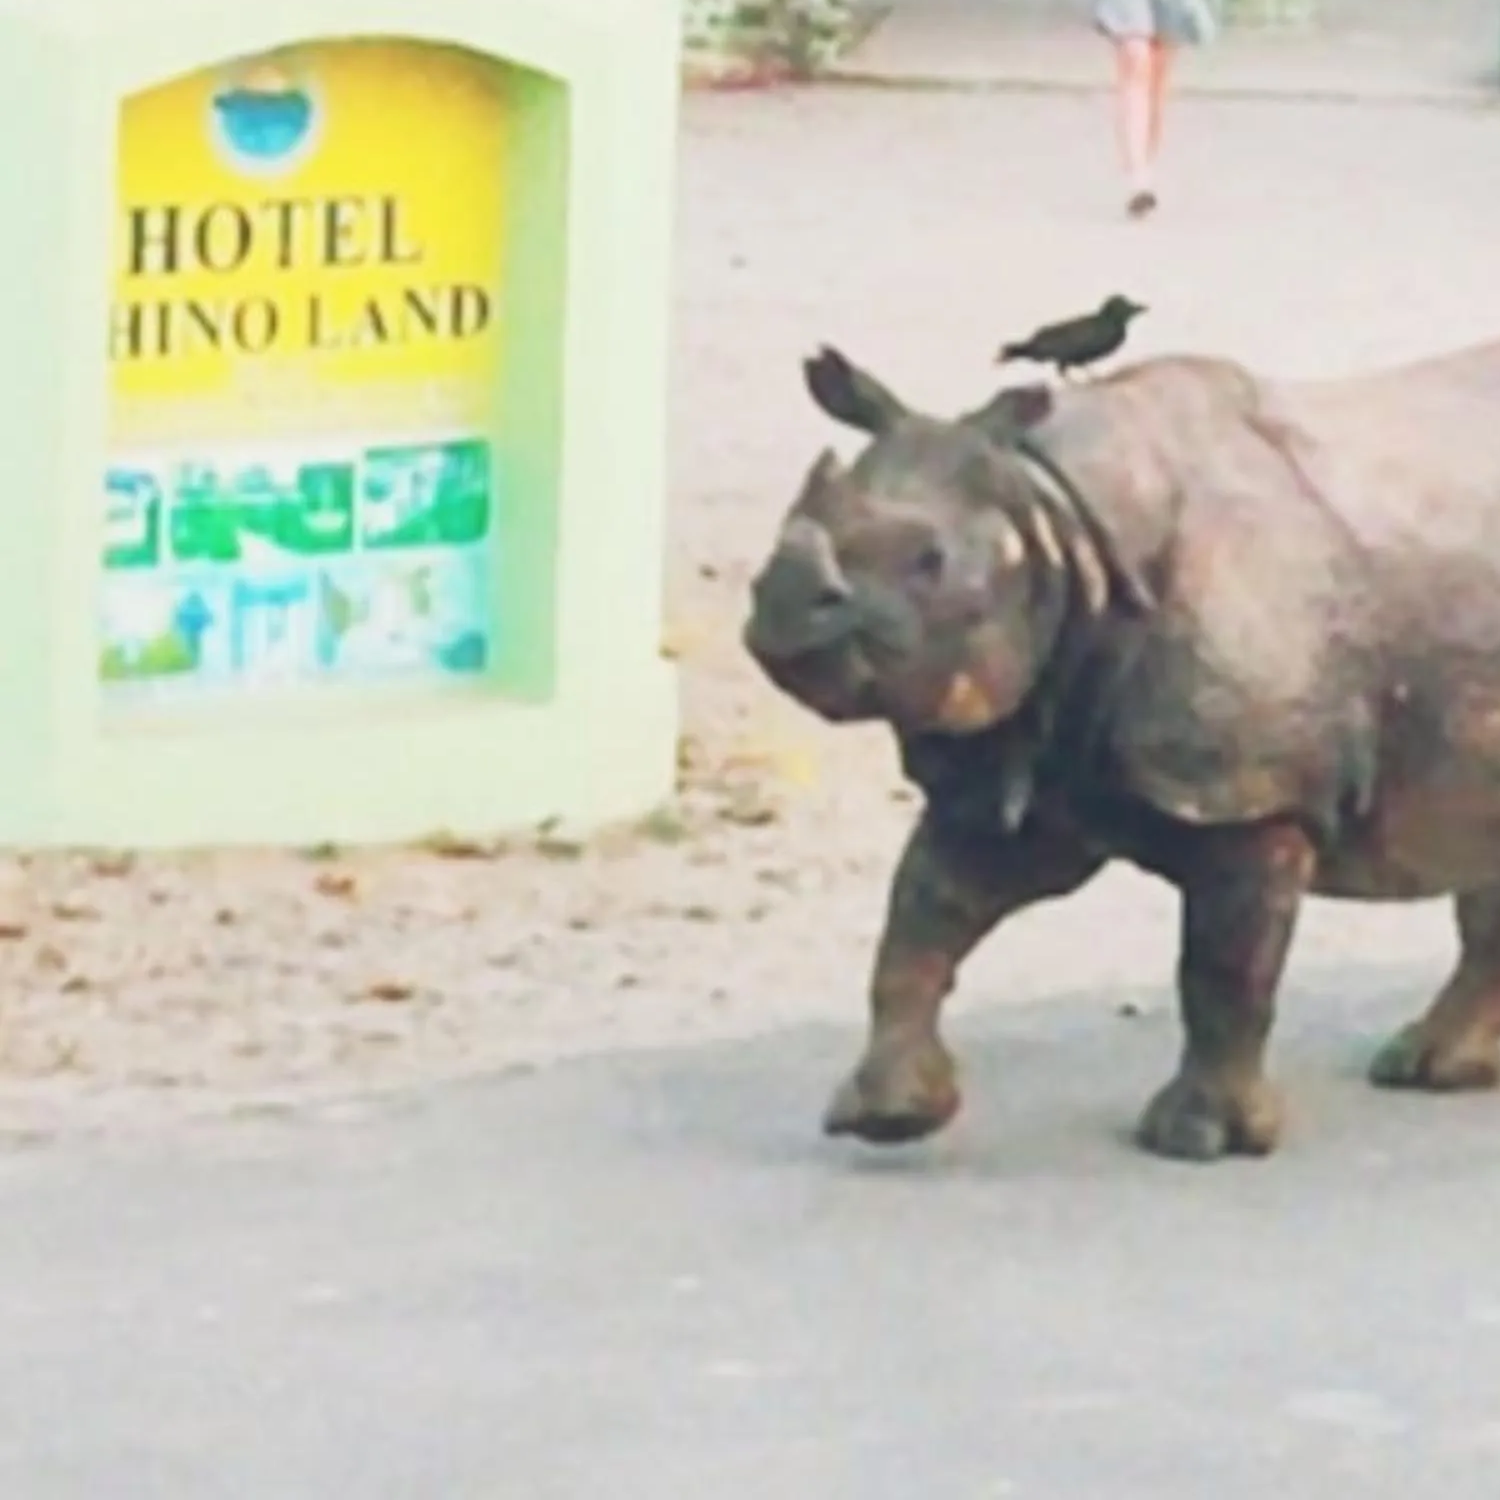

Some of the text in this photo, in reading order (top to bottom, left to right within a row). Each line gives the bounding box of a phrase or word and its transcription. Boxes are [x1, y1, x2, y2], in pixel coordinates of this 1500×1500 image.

[126, 194, 424, 277] HOTEL
[107, 284, 492, 361] HINO LAND
